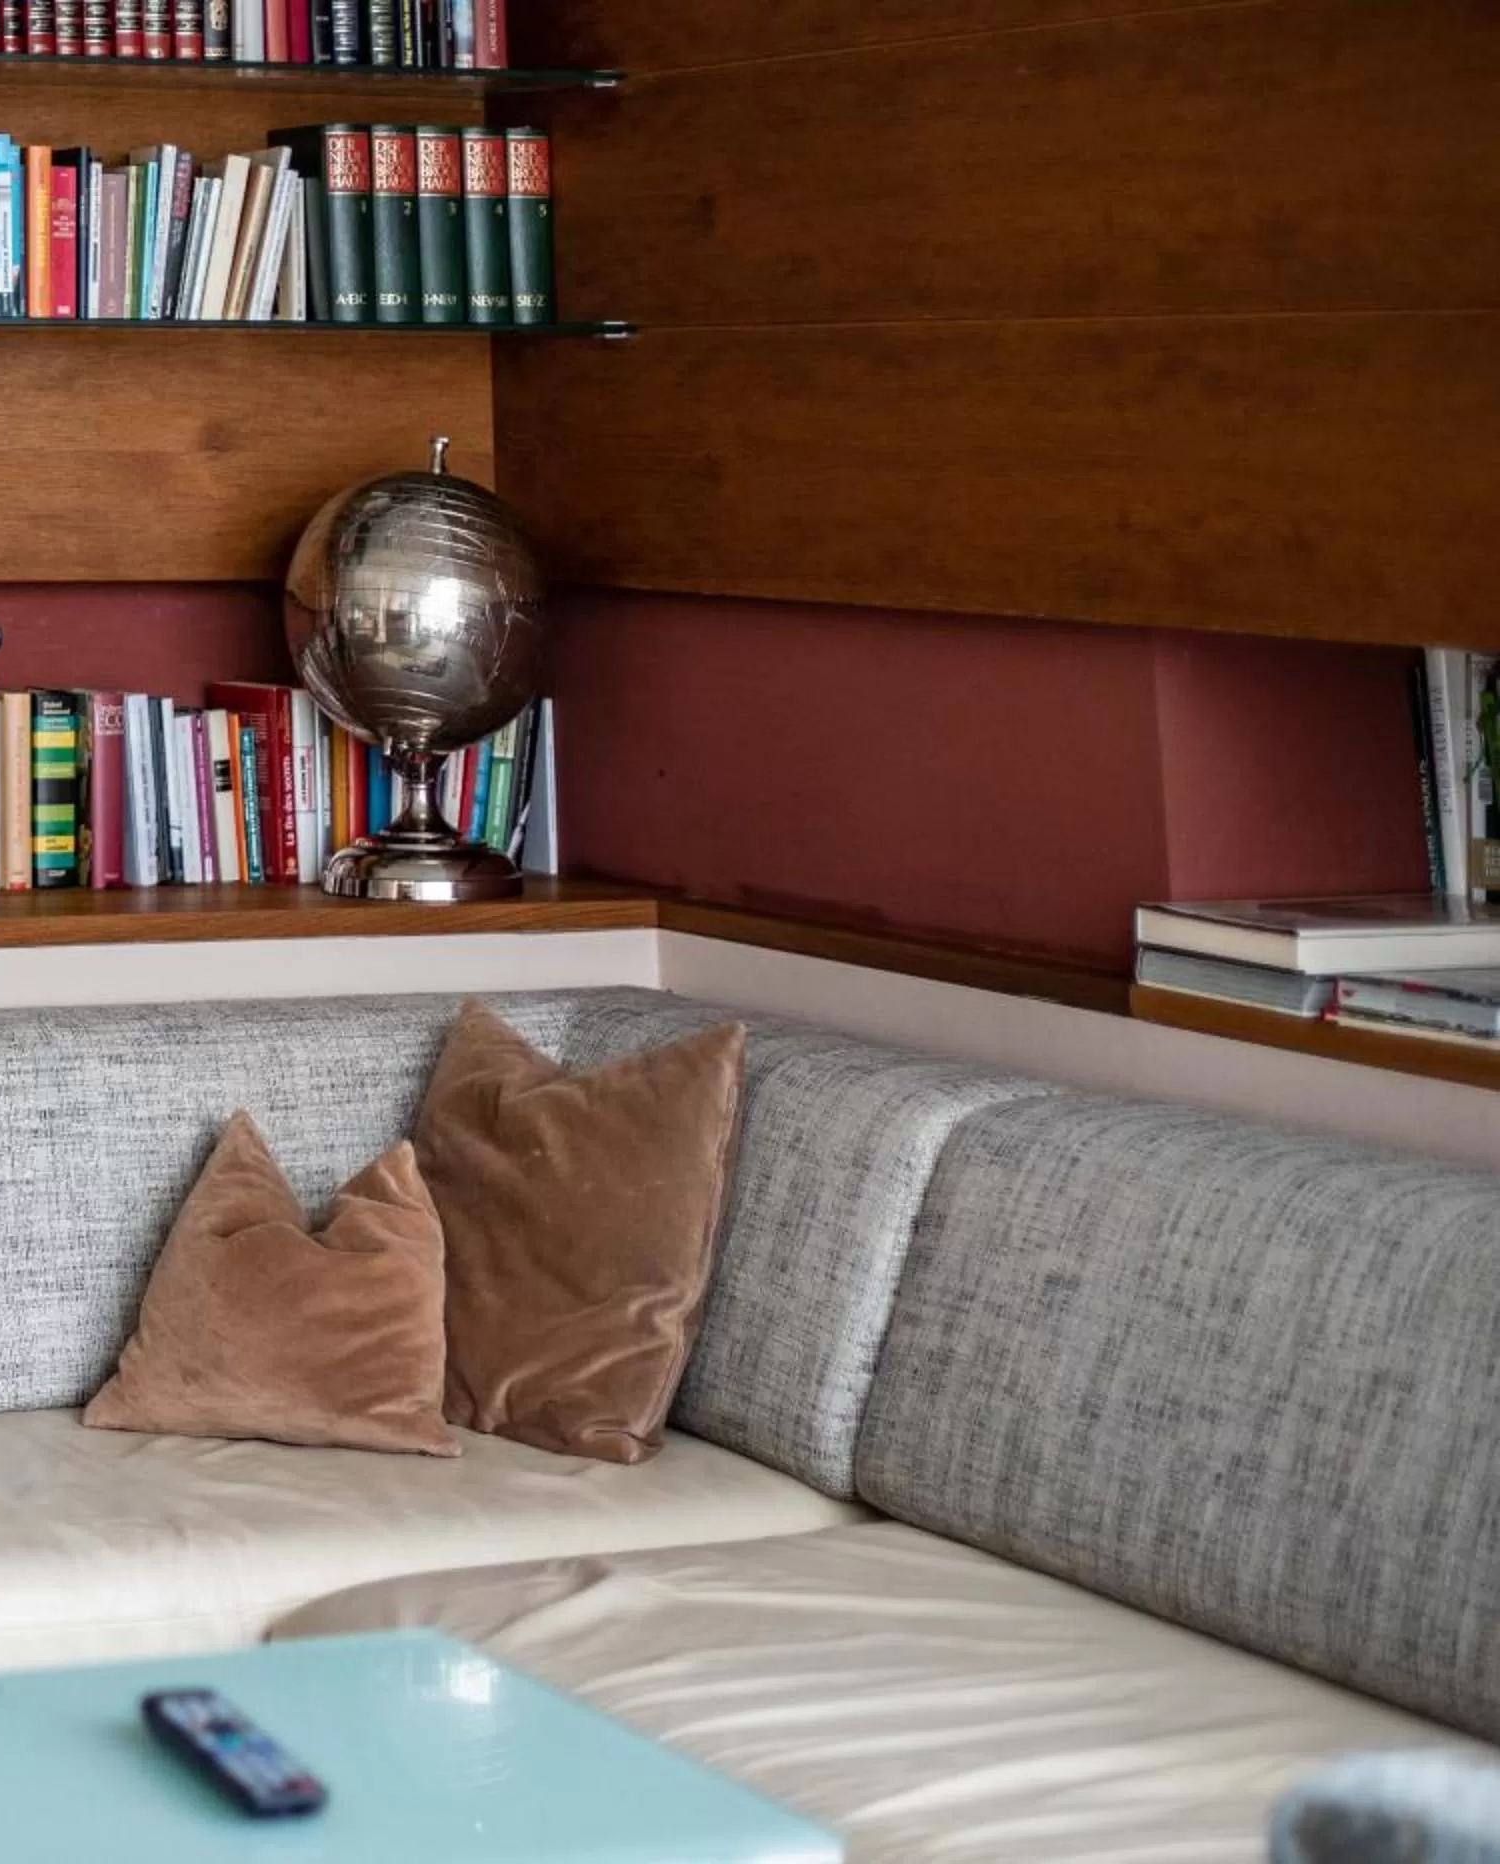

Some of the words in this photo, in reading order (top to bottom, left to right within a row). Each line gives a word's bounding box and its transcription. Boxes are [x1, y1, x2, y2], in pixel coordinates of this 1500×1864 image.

[403, 203, 412, 215] 2
[449, 203, 457, 215] 3
[494, 204, 503, 215] 4
[539, 206, 547, 217] 5
